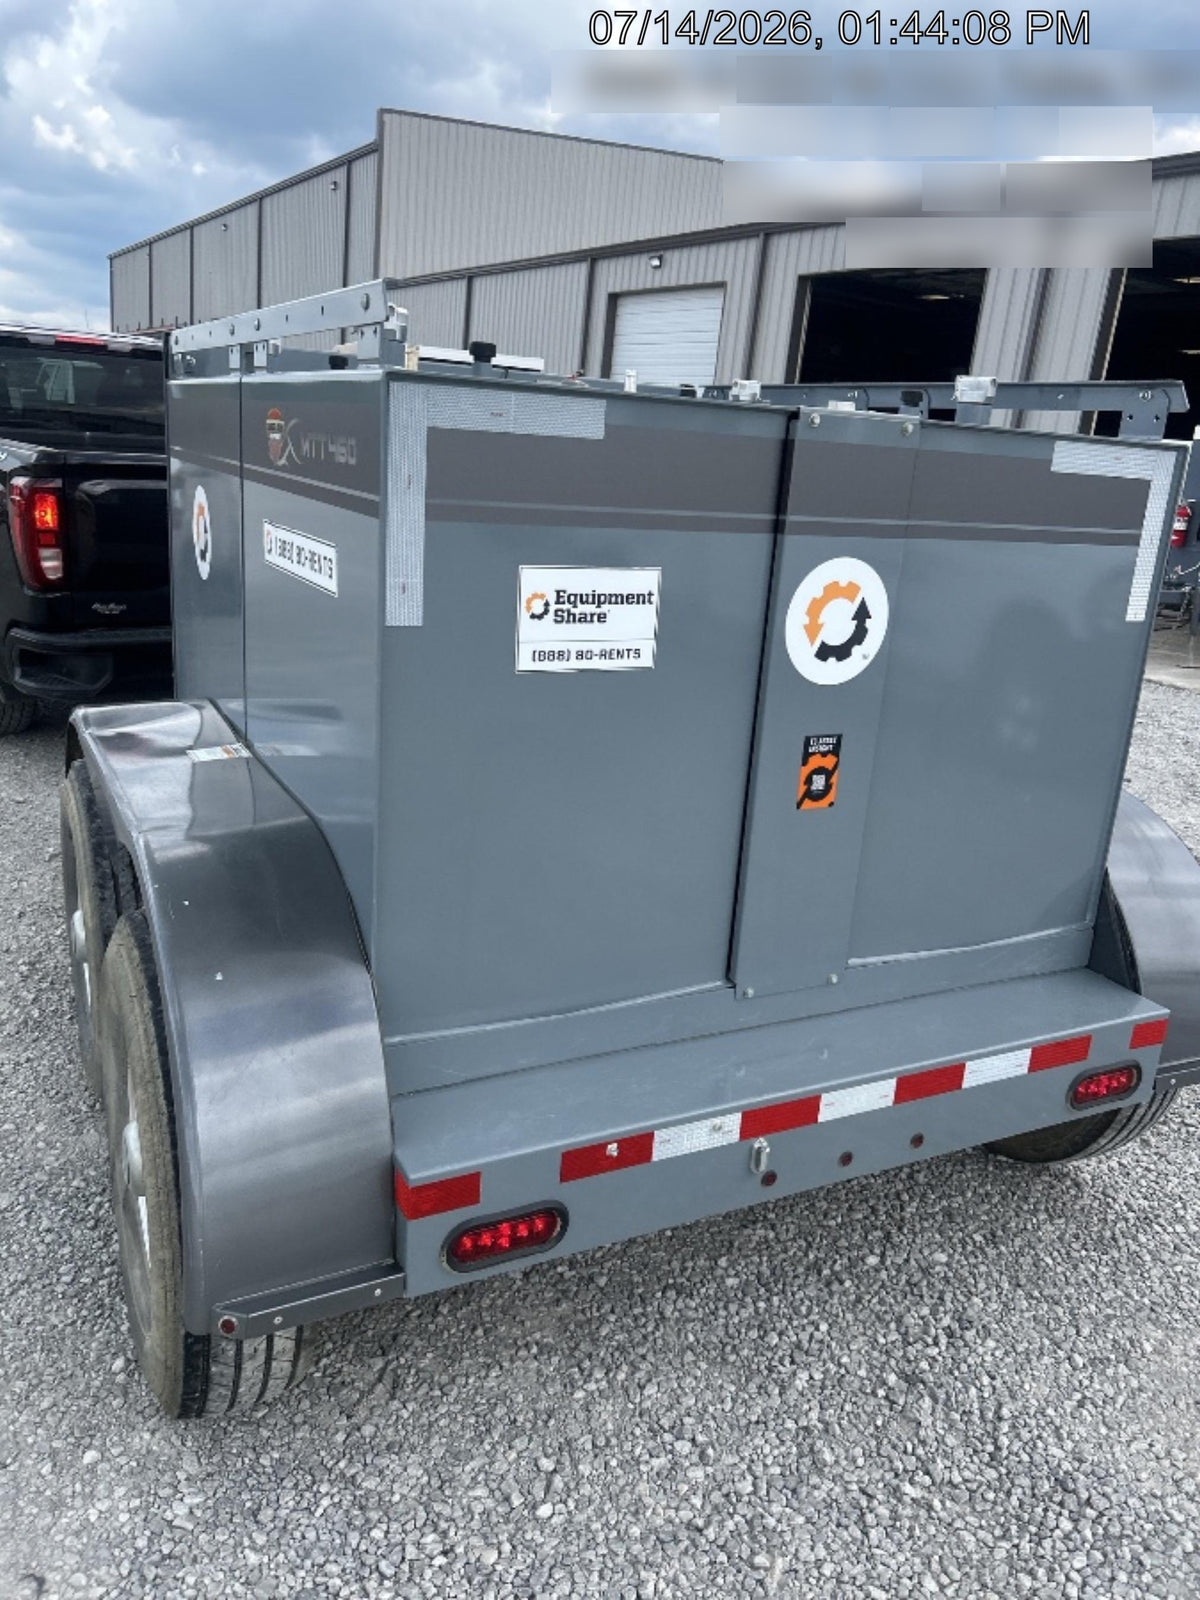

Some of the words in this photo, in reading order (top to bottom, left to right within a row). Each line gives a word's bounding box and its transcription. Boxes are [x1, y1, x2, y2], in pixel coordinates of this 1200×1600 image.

[554, 589, 654, 609] Equipment
[553, 608, 608, 624] Share
[575, 647, 641, 661] 80-RENTS
